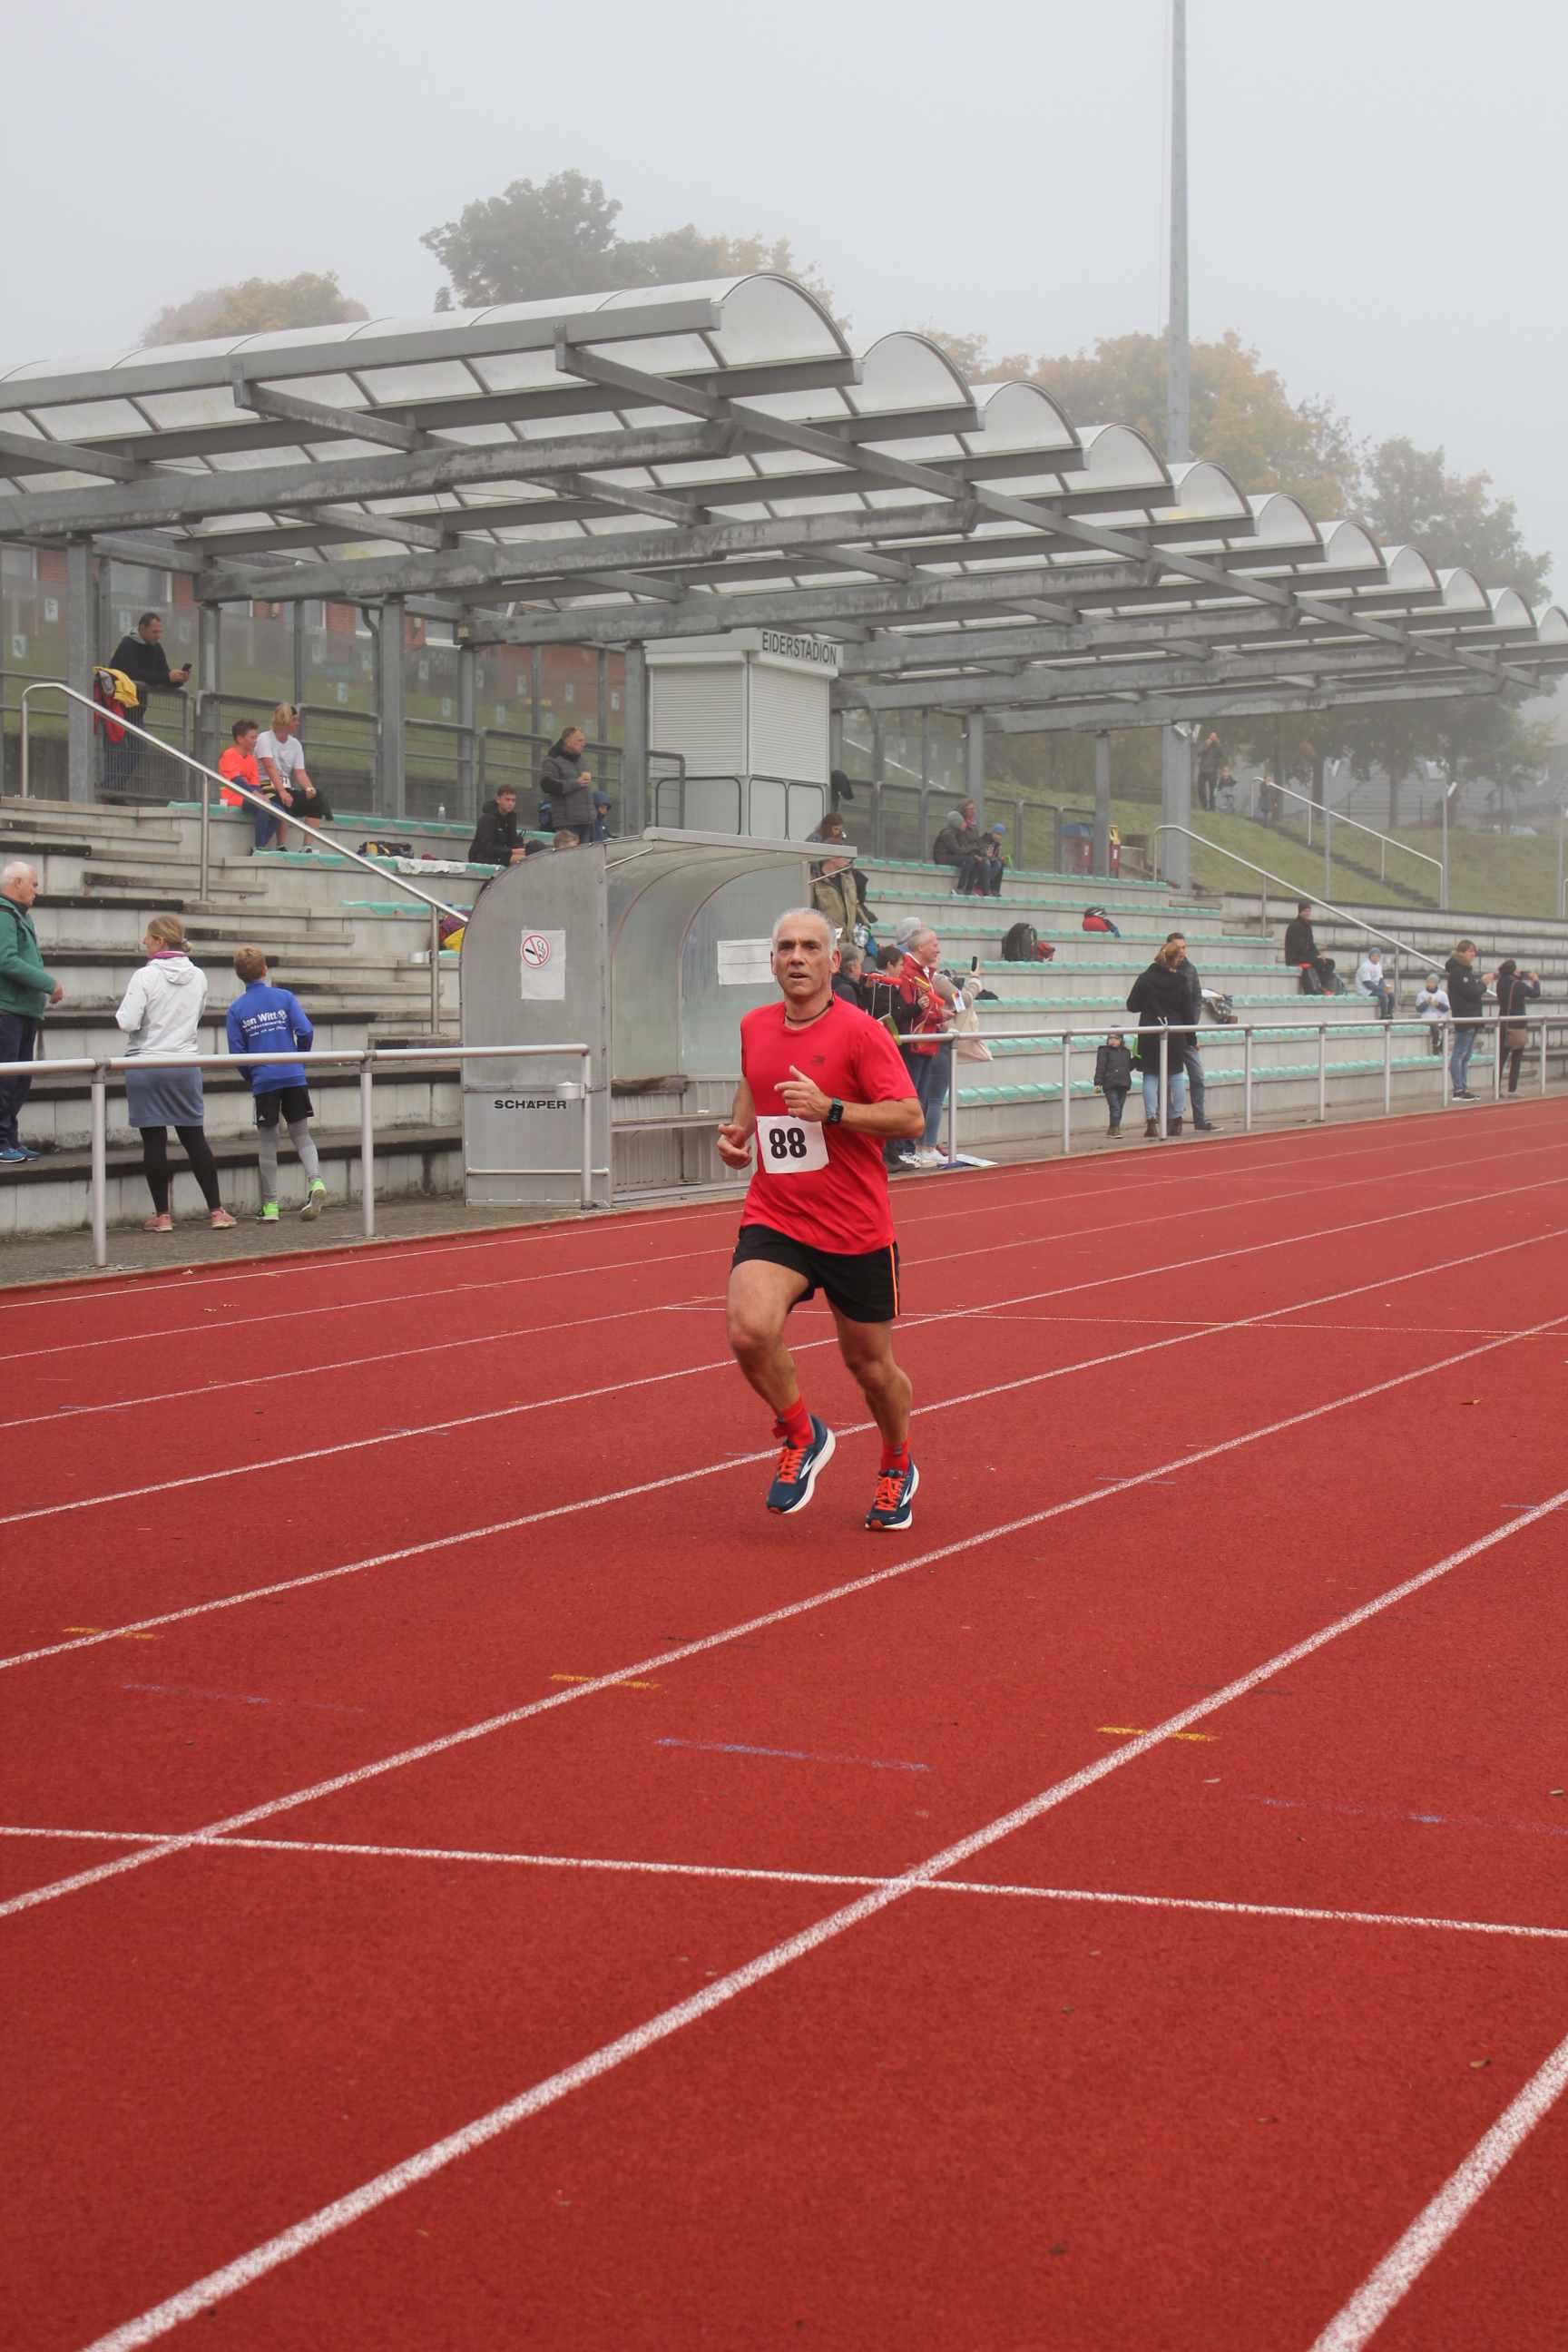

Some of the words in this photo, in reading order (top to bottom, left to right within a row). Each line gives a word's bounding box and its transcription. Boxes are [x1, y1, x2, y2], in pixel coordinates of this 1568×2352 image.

[762, 631, 837, 665] EIDERSTADION
[258, 1011, 278, 1022] Witt
[769, 1127, 808, 1160] 88
